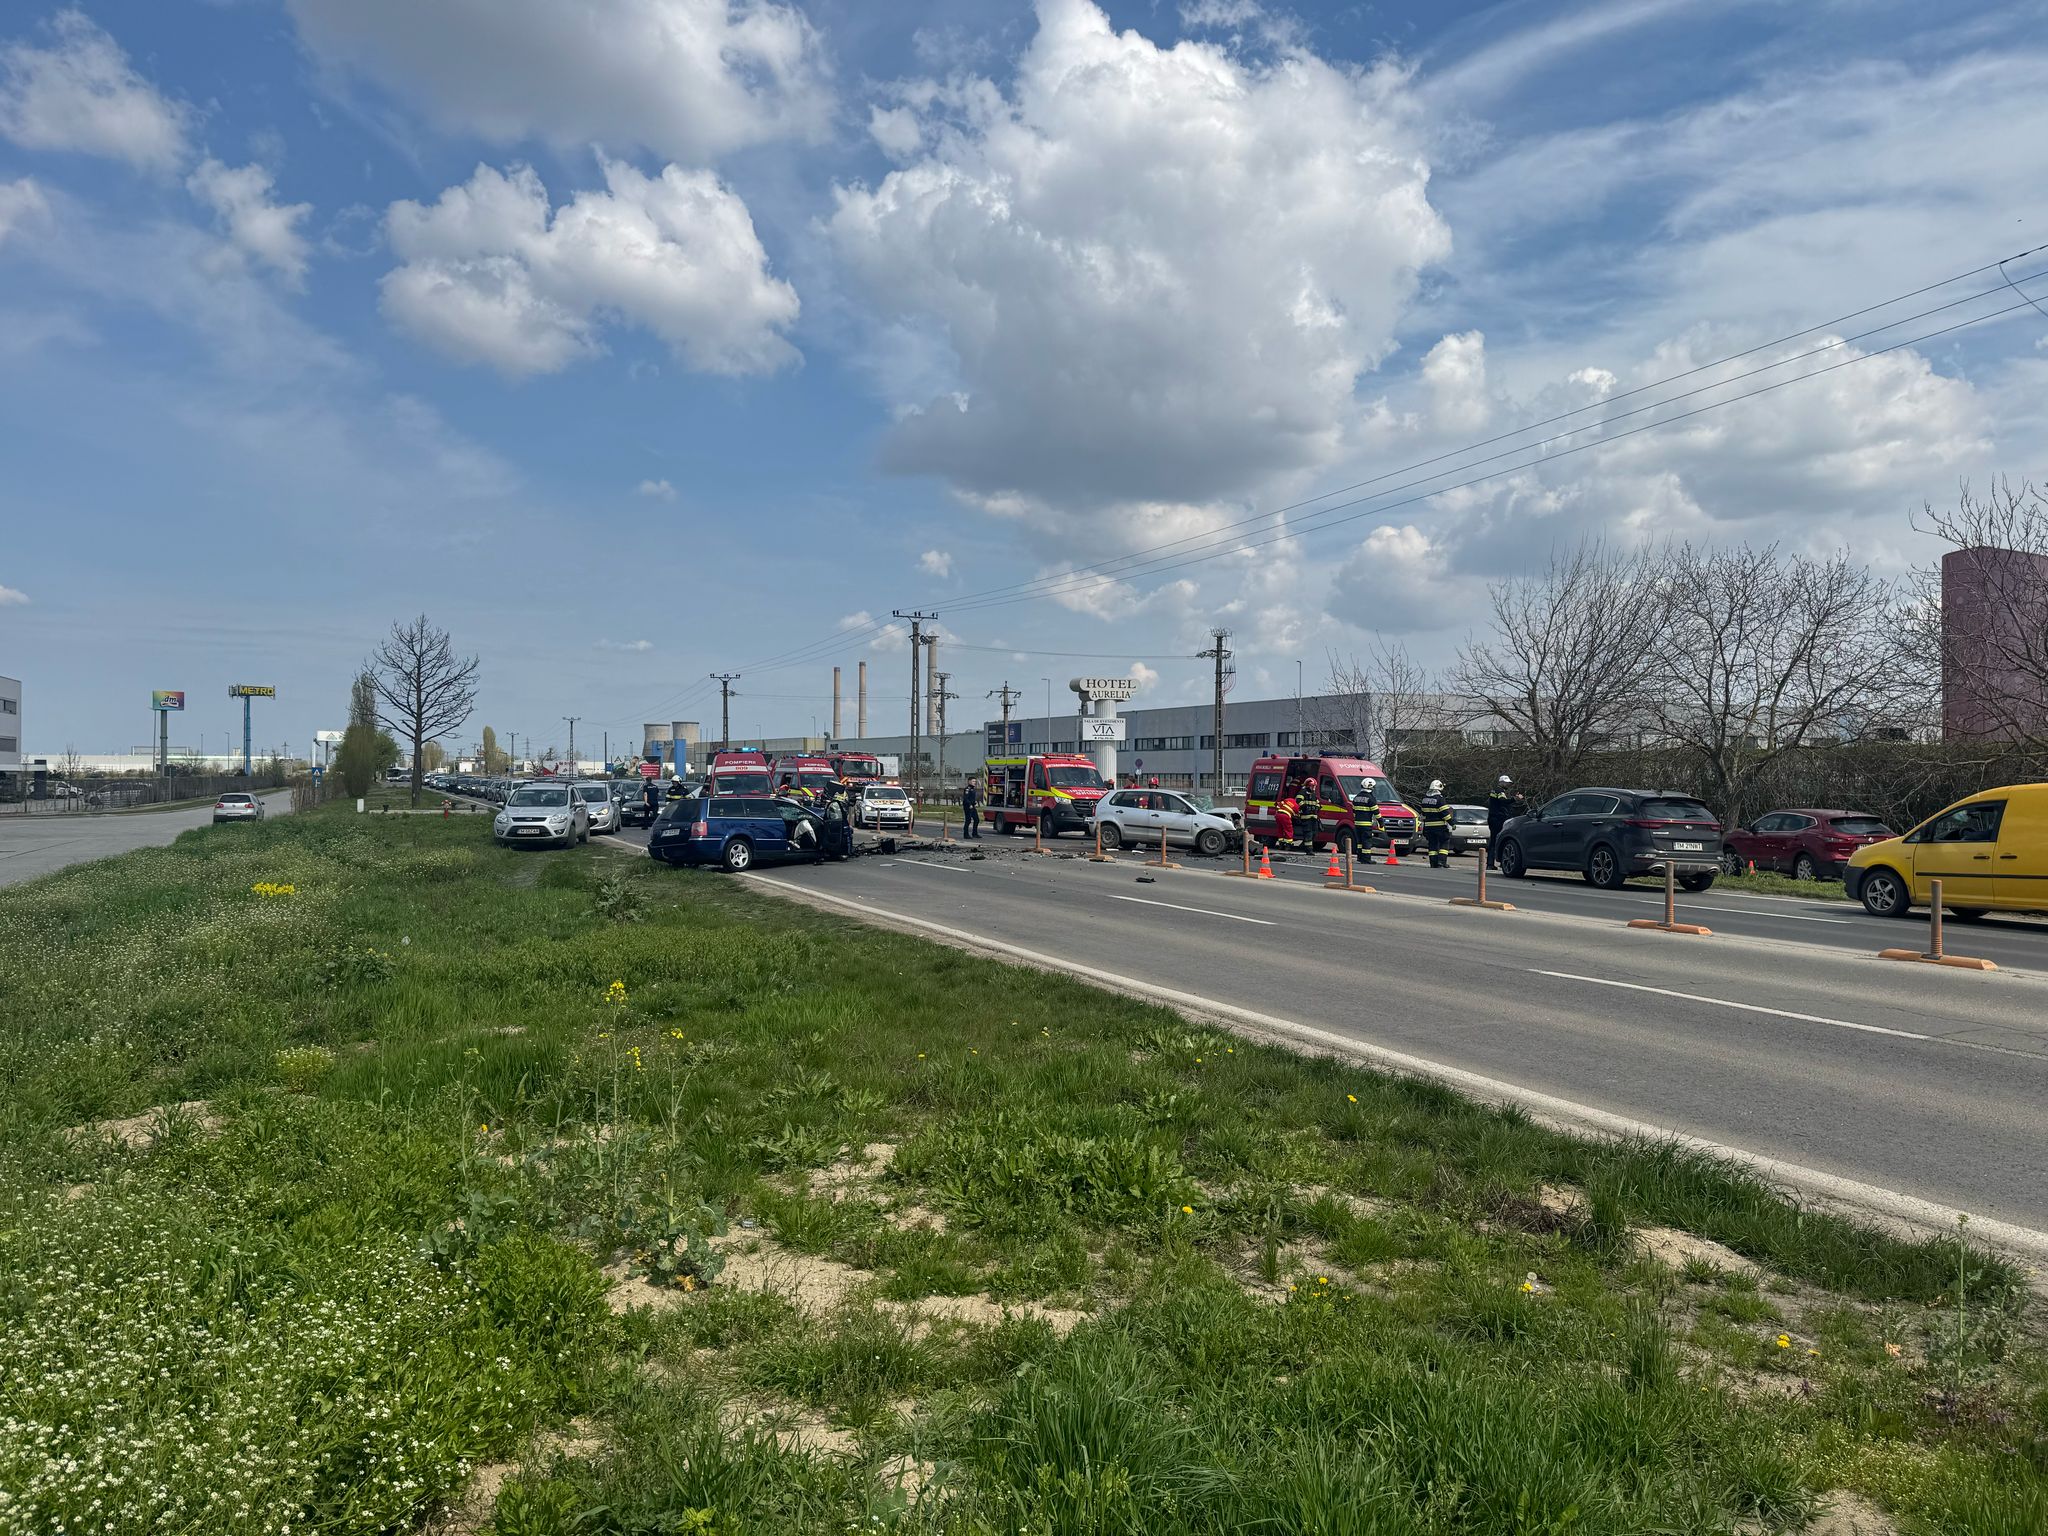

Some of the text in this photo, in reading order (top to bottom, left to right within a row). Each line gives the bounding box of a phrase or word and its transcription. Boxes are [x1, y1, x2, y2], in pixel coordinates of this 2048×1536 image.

[1086, 679, 1136, 689] HOTEL
[239, 687, 274, 695] METRO
[1091, 690, 1131, 698] AURELIA
[164, 695, 177, 703] dm
[1092, 725, 1114, 734] VIA
